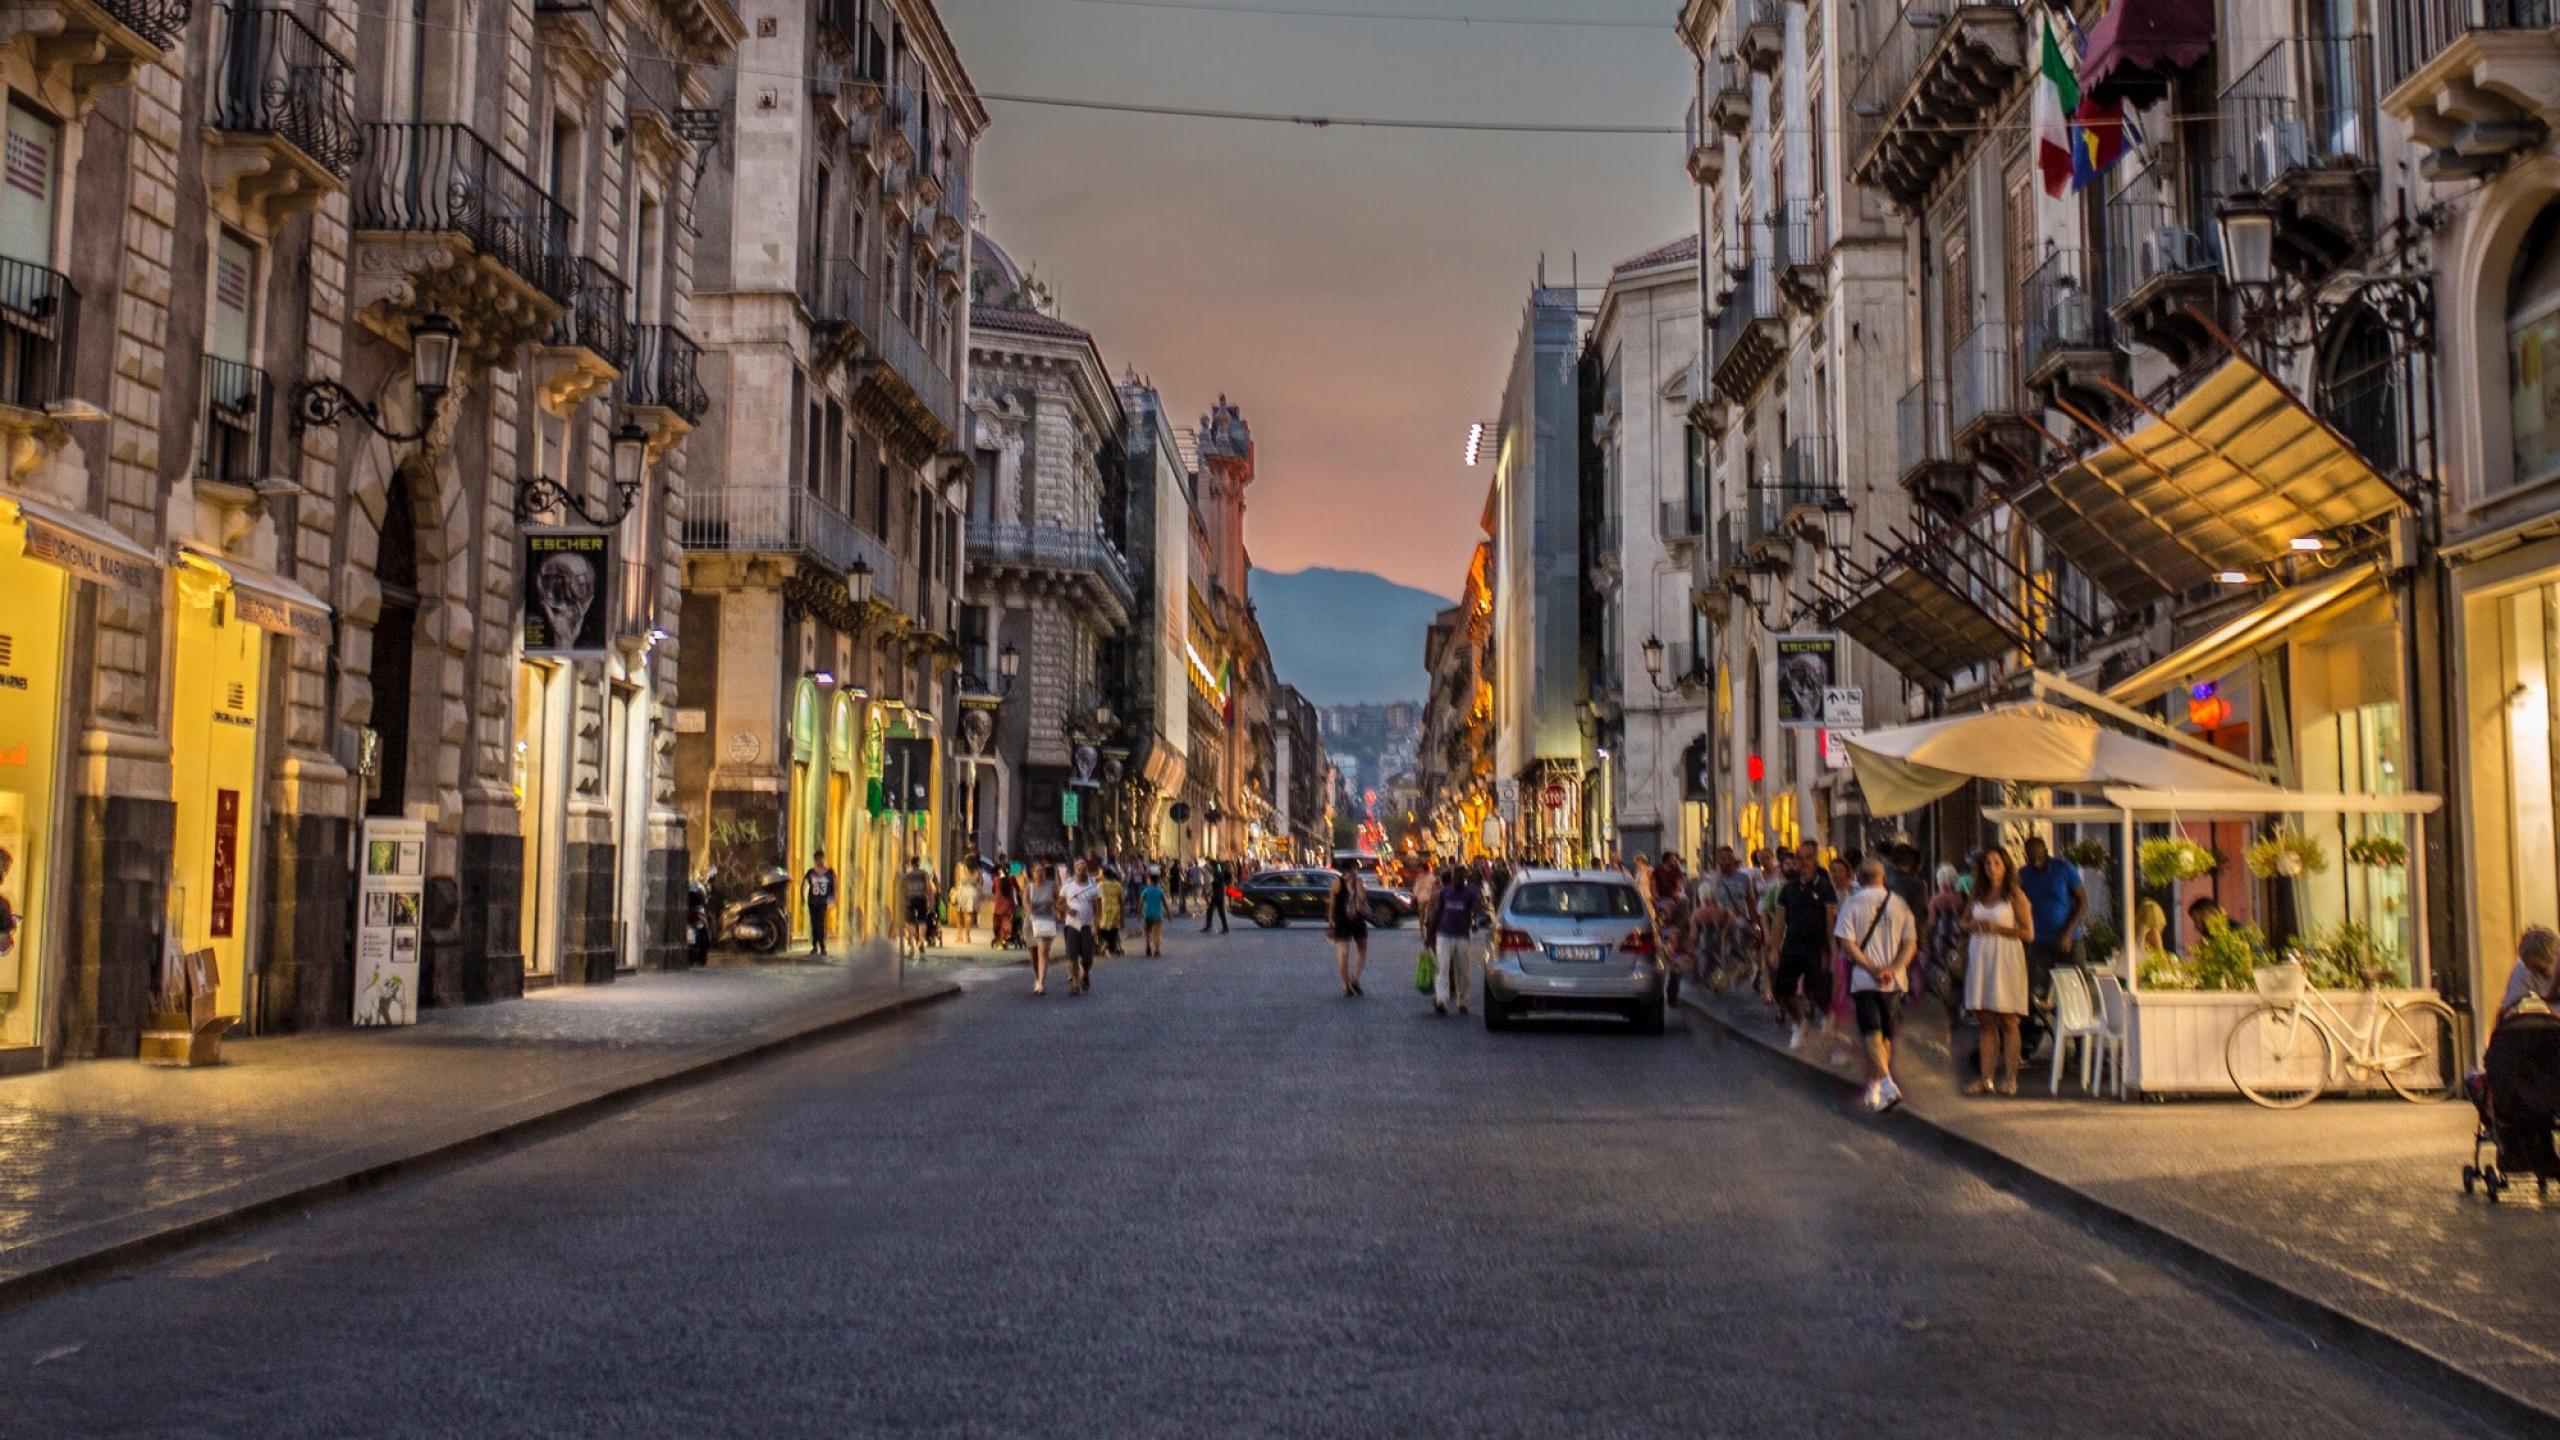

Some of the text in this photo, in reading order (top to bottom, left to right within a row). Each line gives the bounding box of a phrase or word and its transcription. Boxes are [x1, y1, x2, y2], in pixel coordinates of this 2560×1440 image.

[532, 539, 603, 550] ESCHER
[53, 538, 142, 588] ORIGINAL MARINES
[1782, 643, 1832, 652] ESCHER
